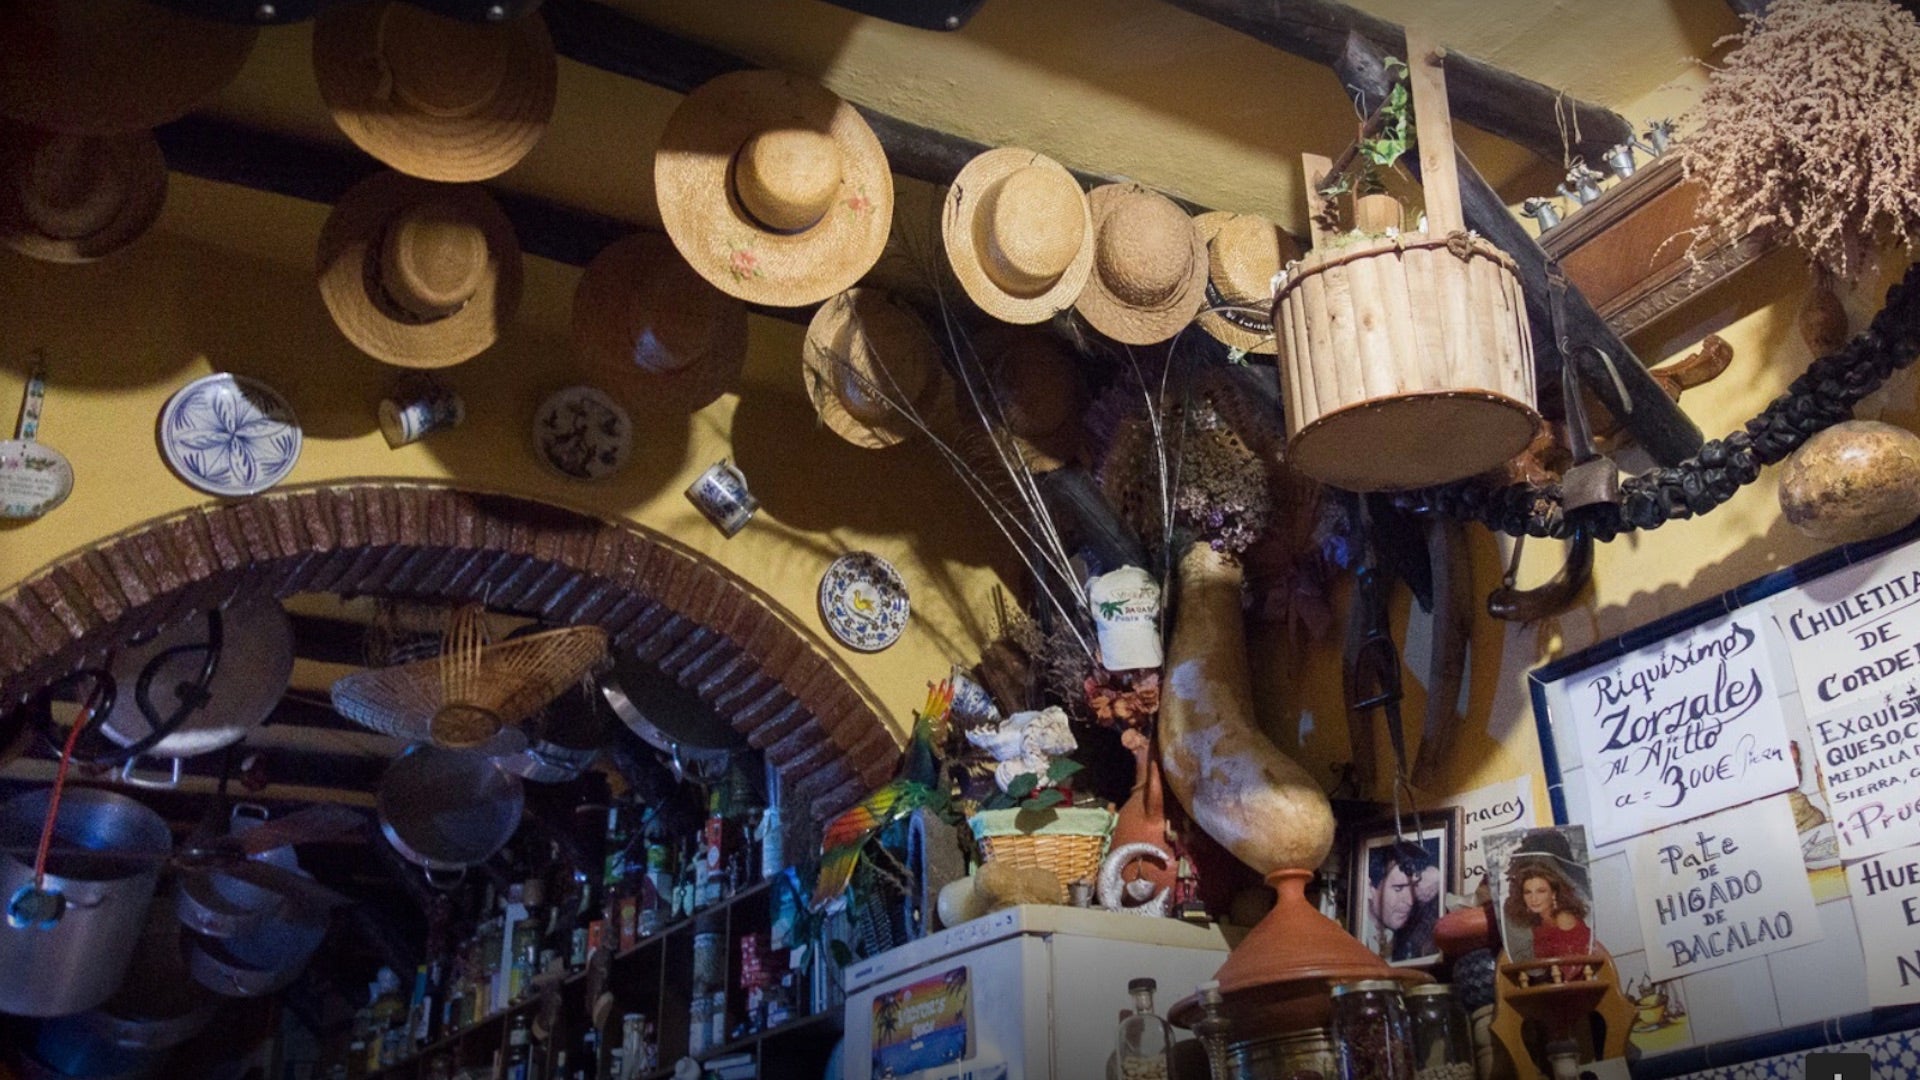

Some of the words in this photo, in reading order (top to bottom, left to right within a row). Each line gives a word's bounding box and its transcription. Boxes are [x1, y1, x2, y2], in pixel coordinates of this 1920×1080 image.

[1855, 621, 1902, 651] DE
[1598, 658, 1763, 754] Zorzales
[1828, 749, 1912, 788] MEDALLA
[1658, 831, 1739, 875] Pate
[1697, 863, 1720, 881] DE
[1656, 869, 1763, 925] HIGADO
[1702, 909, 1728, 927] DE
[1667, 911, 1793, 969] BACALAO
